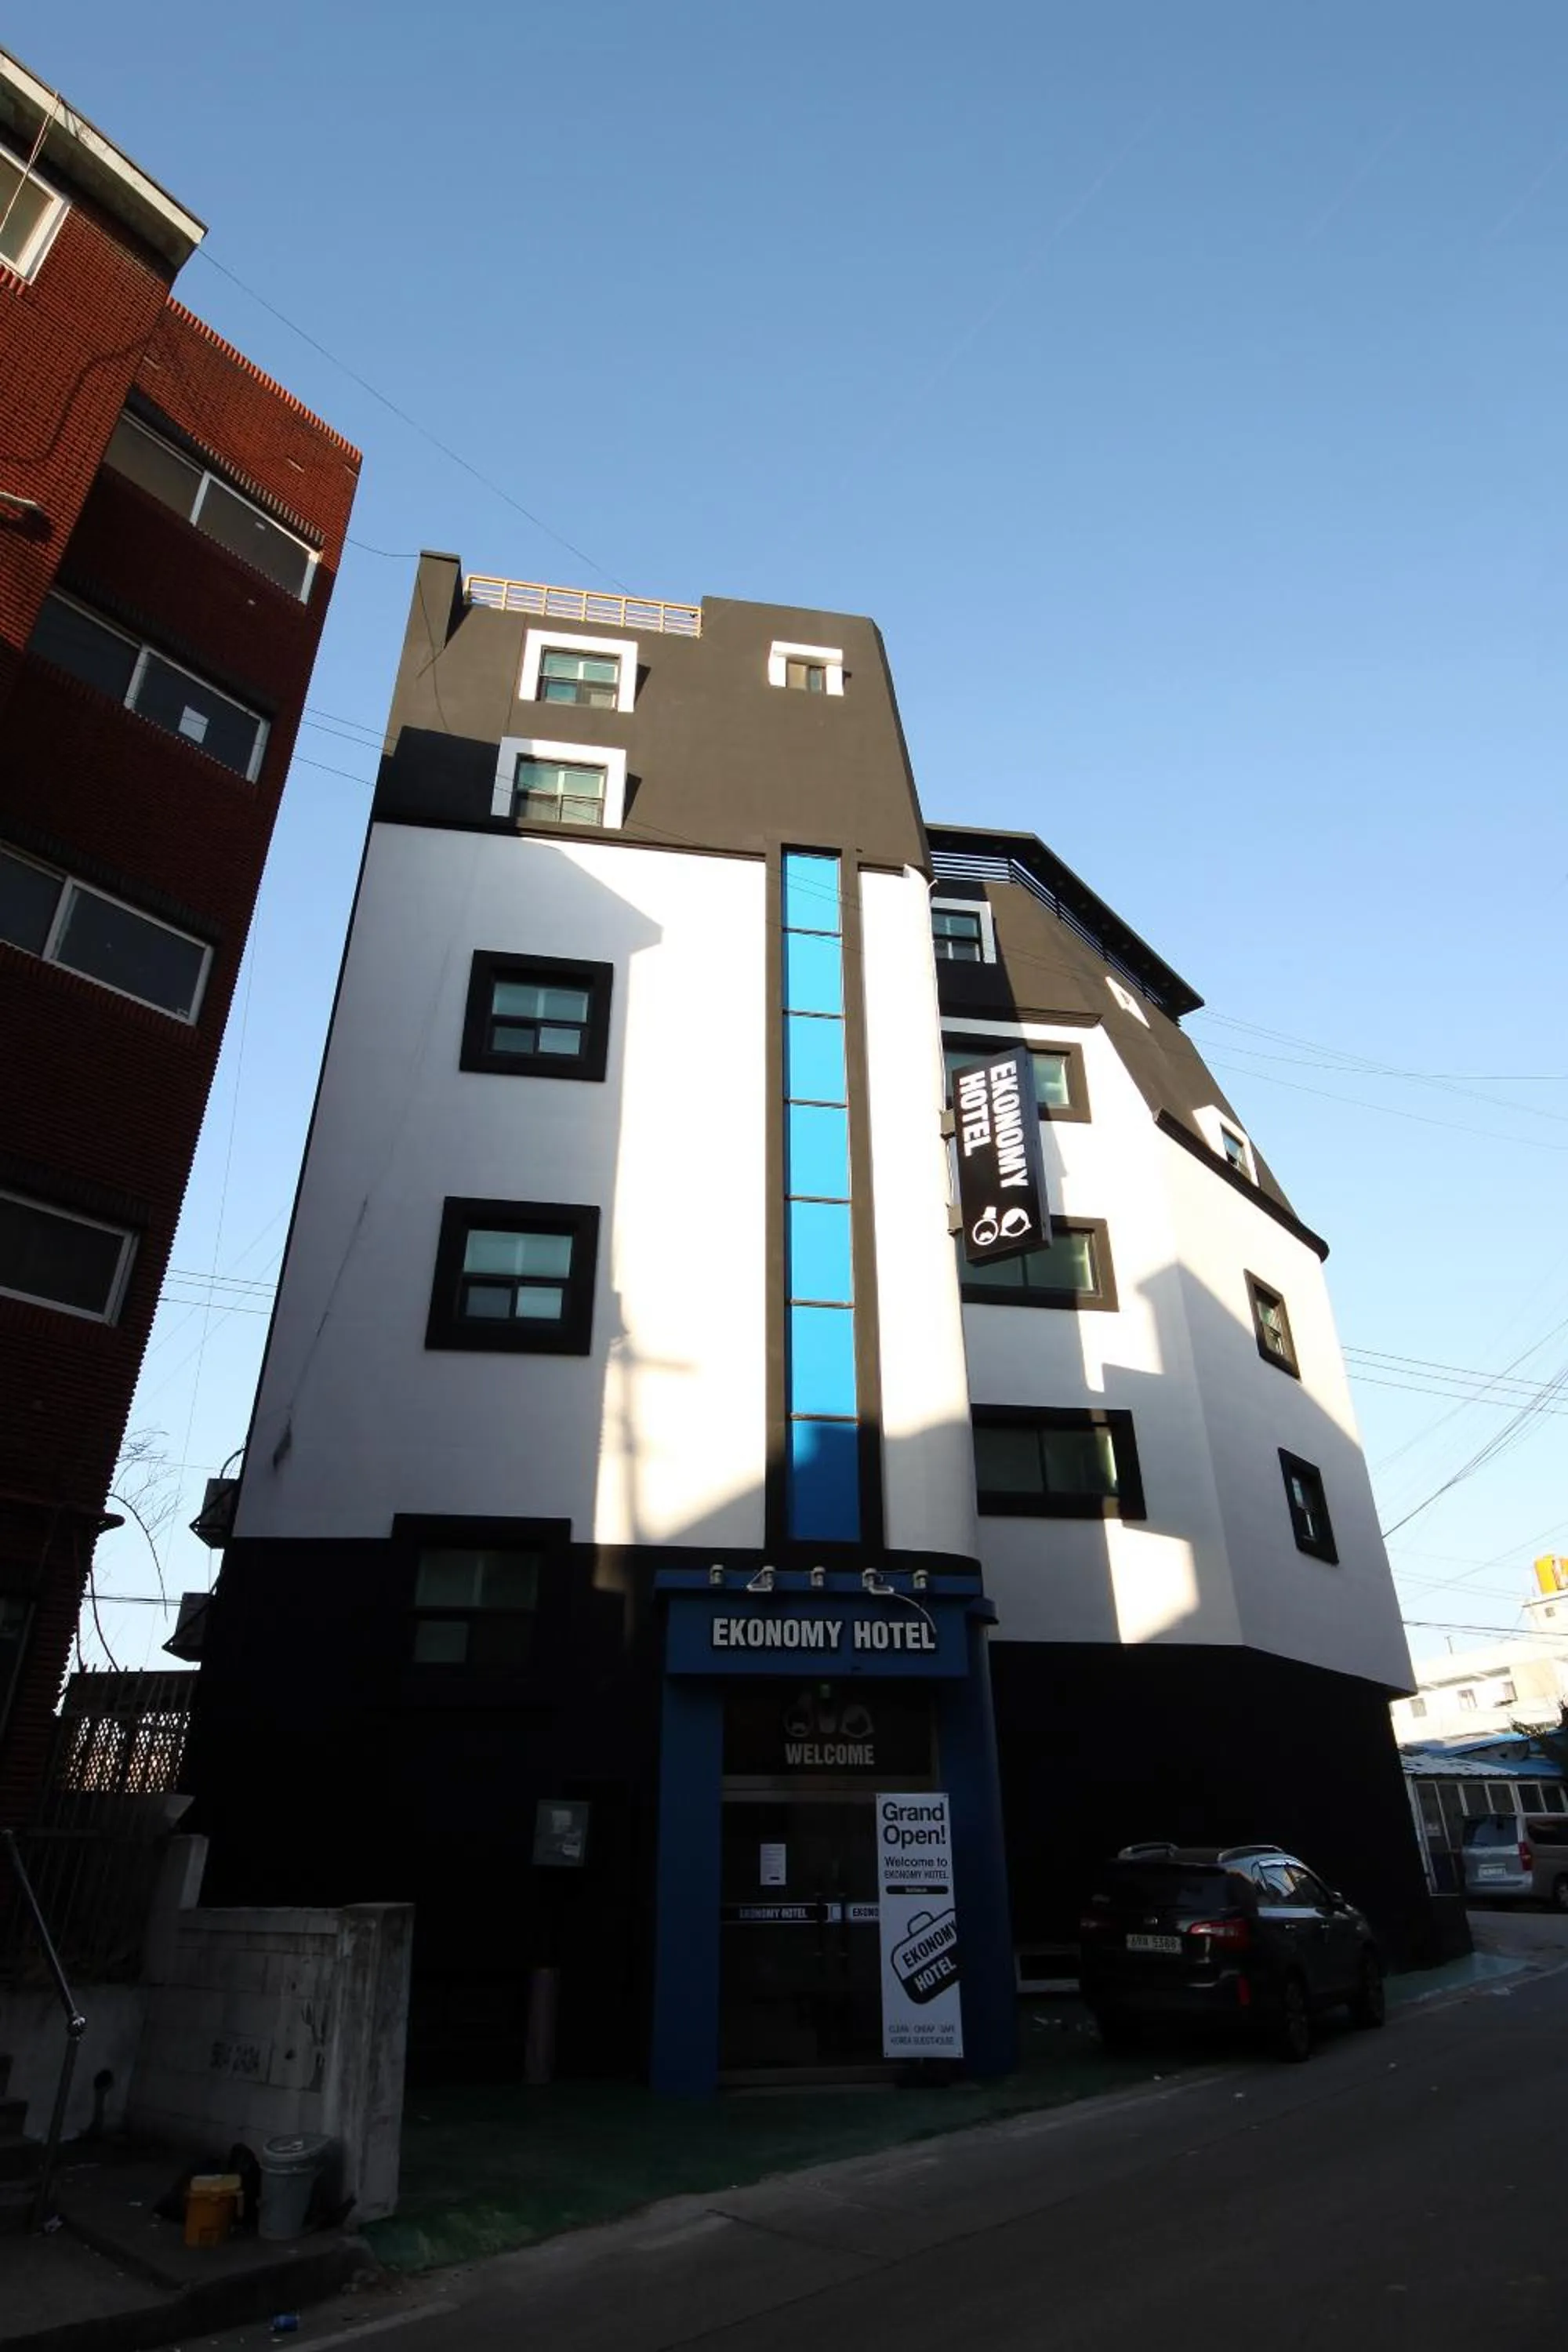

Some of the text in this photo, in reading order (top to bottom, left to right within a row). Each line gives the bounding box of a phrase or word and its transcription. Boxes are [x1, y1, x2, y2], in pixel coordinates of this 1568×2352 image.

[959, 1071, 991, 1156] HOTEL
[990, 1058, 1029, 1189] EKONOMY
[712, 1617, 937, 1650] EKONOMY HOTEL
[784, 1742, 876, 1766] WELCOME
[882, 1801, 945, 1821] Grand
[883, 1824, 947, 1849] Open!
[884, 1856, 949, 1867] Welcome to
[902, 1919, 958, 1969] EKONOMY
[913, 1956, 957, 1993] HOTEL
